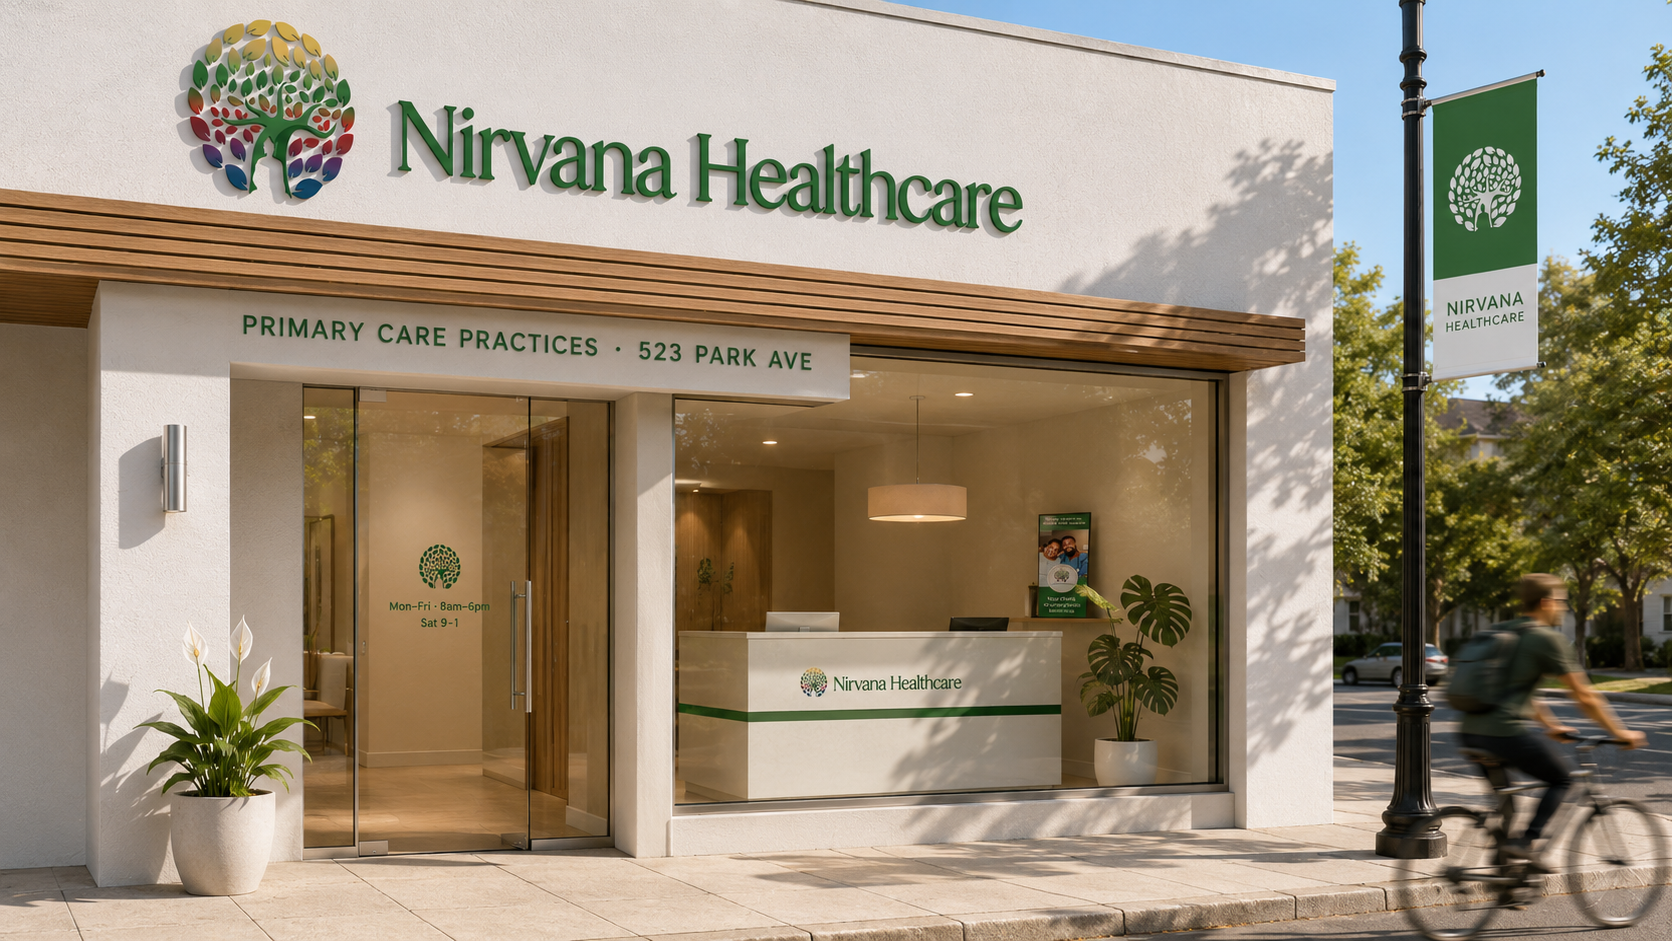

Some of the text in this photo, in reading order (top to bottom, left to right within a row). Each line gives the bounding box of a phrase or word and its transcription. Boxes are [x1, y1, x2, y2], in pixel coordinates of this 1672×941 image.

[398, 100, 1024, 234] Nirvana Healthcare
[1447, 291, 1524, 317] NIRVANA
[1445, 310, 1524, 333] HEALTHCARE
[242, 314, 365, 342] PRIMARY
[377, 323, 447, 347] CARE
[459, 328, 598, 357] PRACTICES
[638, 341, 682, 362] 523
[695, 344, 756, 367] PARK
[768, 350, 813, 371] AVE
[421, 618, 437, 628] Sat
[833, 674, 962, 692] Nirvana Healthcare
